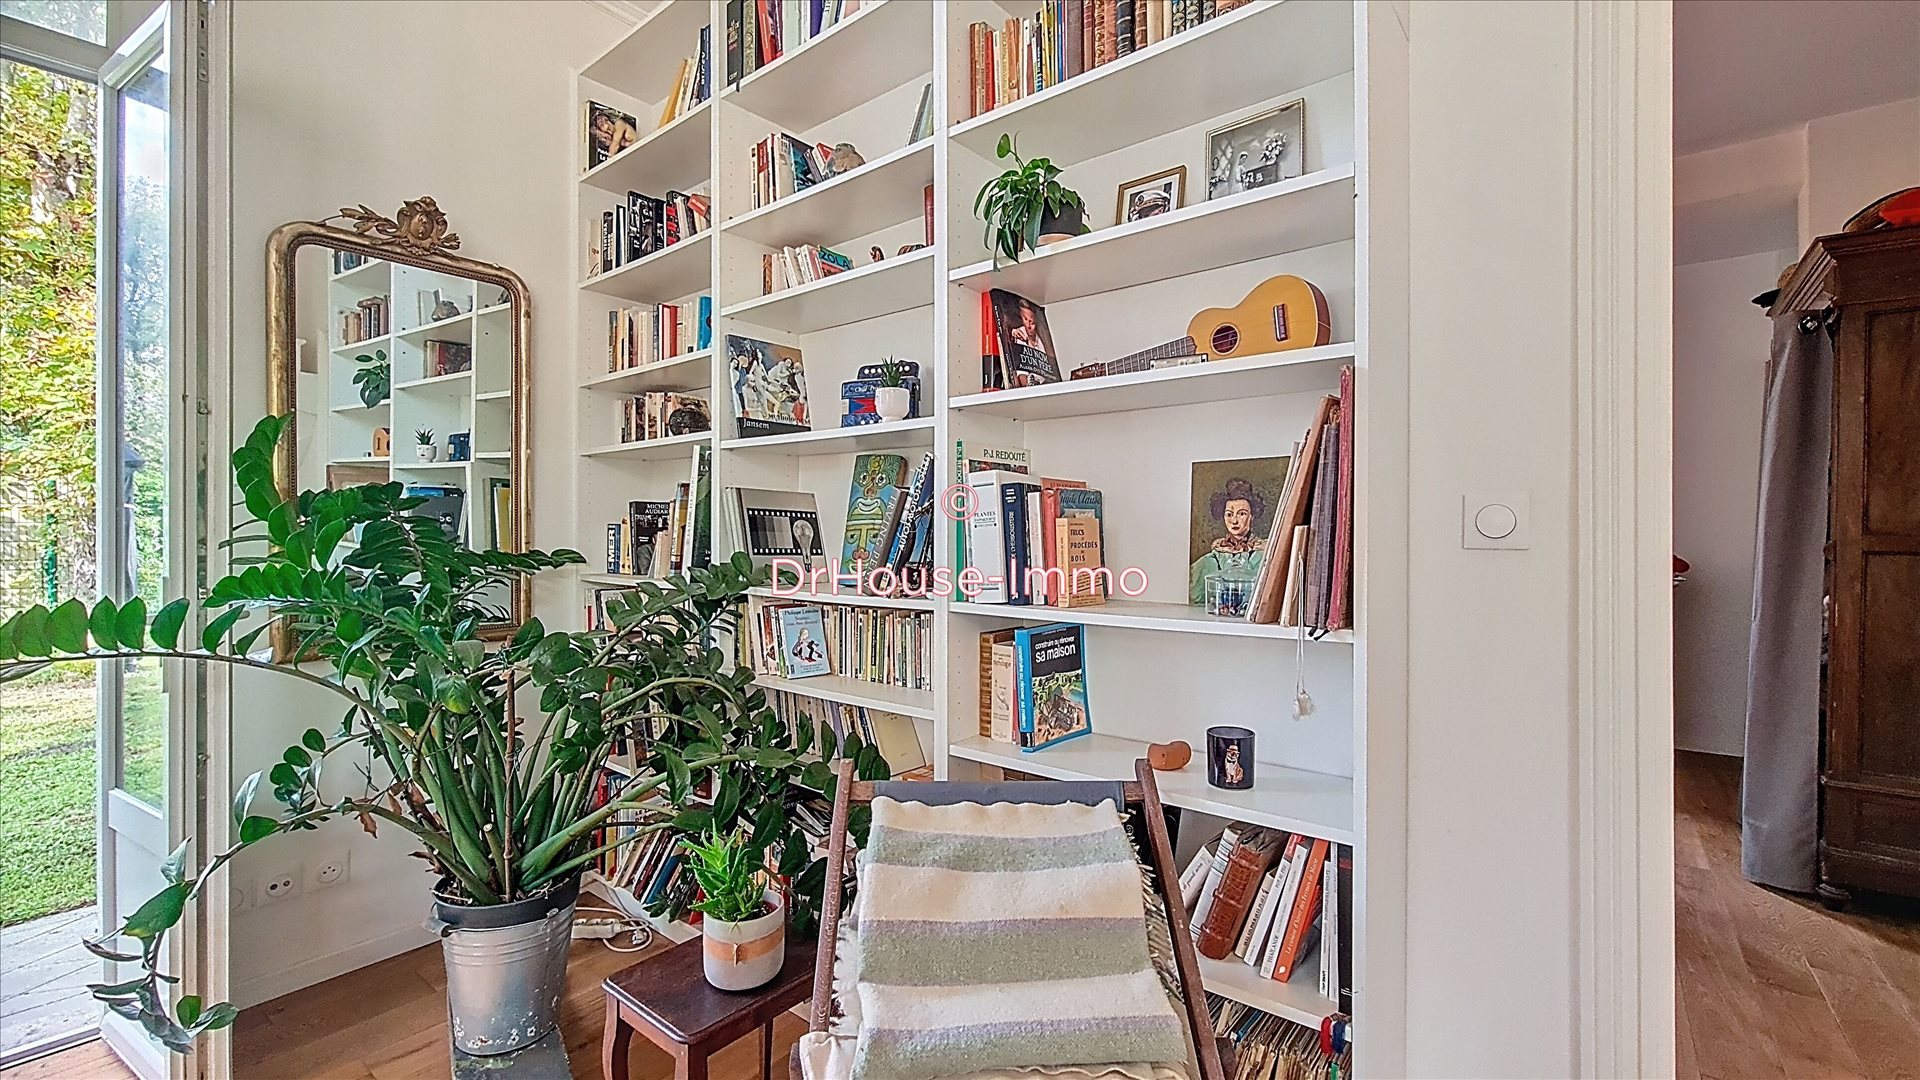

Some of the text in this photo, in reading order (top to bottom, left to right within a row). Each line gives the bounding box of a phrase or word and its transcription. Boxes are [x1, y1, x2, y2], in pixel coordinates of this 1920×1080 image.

[820, 251, 850, 270] ZOLA
[744, 418, 770, 430] Jansem
[996, 450, 1026, 462] REDOUTÉ
[876, 495, 896, 548] IRVING
[1035, 644, 1076, 663] sa maison
